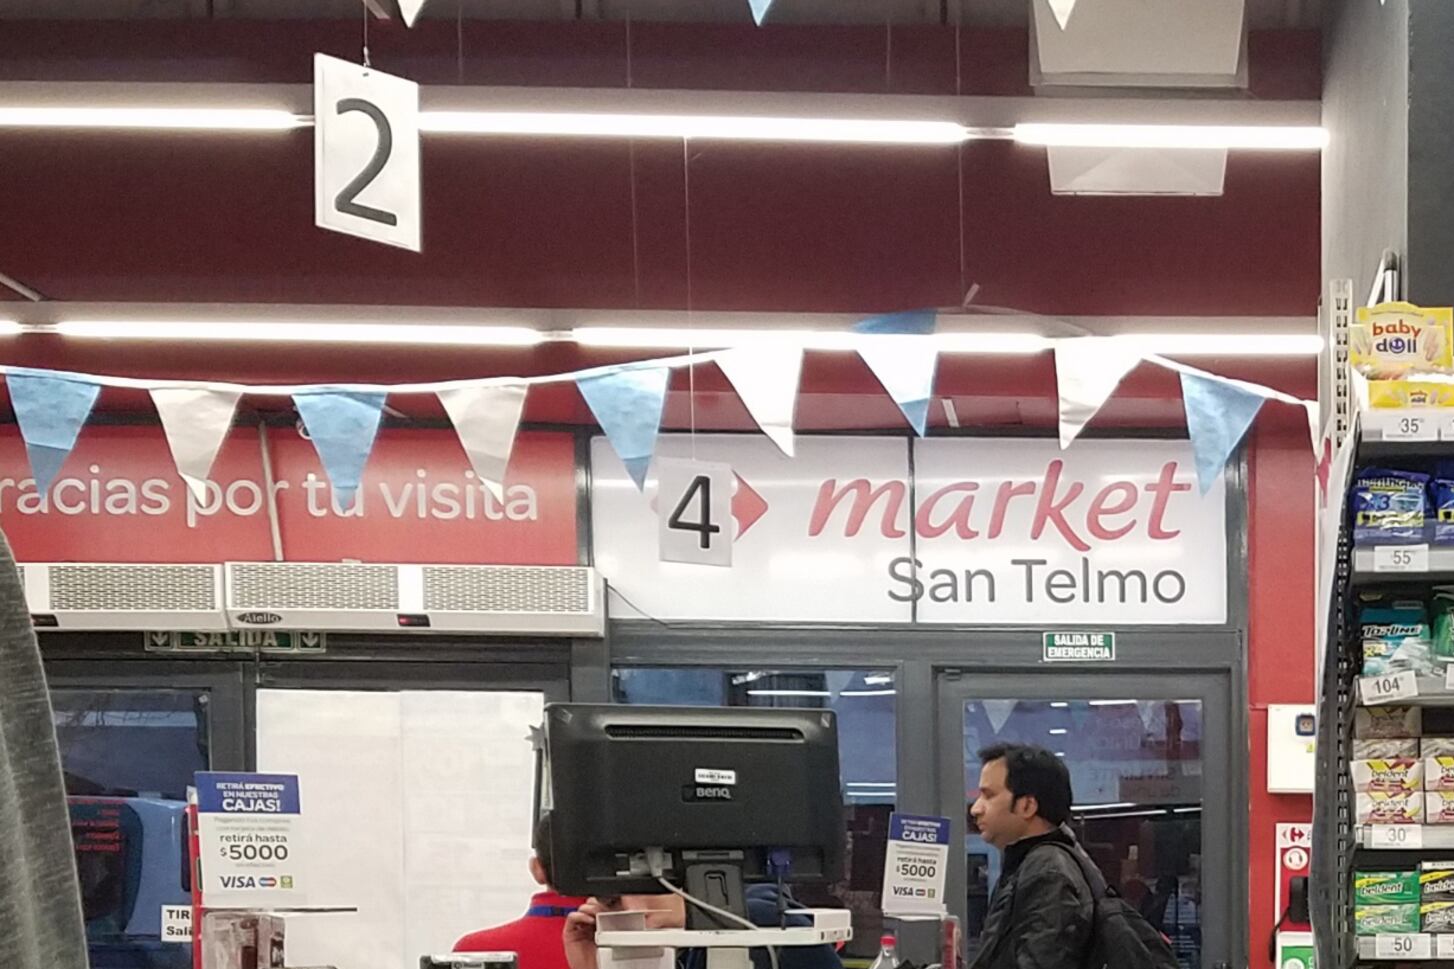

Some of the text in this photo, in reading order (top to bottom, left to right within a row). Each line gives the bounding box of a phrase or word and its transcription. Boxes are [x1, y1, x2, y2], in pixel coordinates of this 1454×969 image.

[334, 98, 397, 226] 2
[1373, 319, 1421, 338] baby
[1401, 419, 1418, 432] 35
[187, 479, 289, 528] por
[302, 473, 364, 517] tu
[378, 468, 538, 521] visita
[808, 459, 1191, 552] market
[668, 476, 719, 549] 4
[887, 556, 1186, 603] San Telmo
[193, 631, 277, 647] SALIDA
[1054, 634, 1104, 646] SALIDA DE
[1047, 647, 1110, 658] EMERGENCIA
[1375, 677, 1400, 694] 104
[696, 787, 732, 799] BenQ
[222, 799, 281, 812] CAJAS!
[220, 833, 287, 843] retirá hasta
[220, 844, 288, 861] $5000
[220, 876, 256, 888] VISA
[893, 886, 914, 896] VISA
